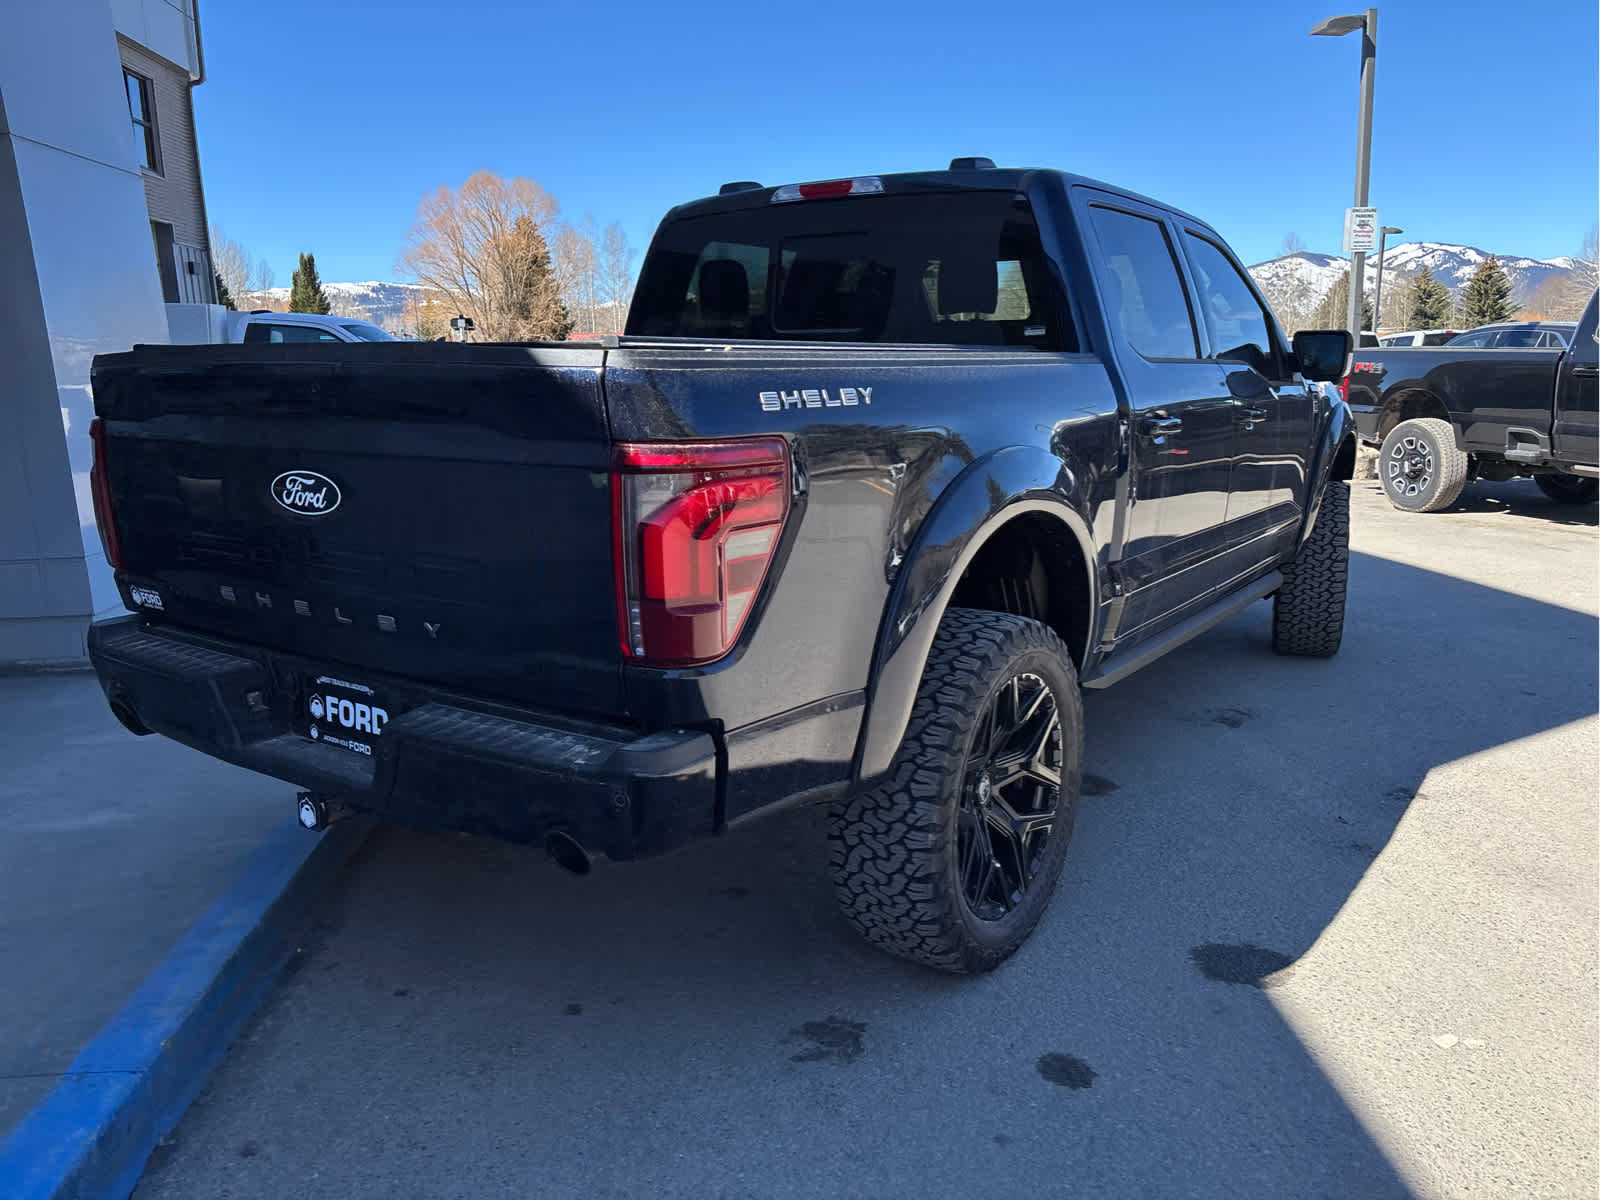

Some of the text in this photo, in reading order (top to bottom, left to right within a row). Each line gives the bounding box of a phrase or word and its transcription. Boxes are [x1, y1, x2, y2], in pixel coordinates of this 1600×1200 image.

[759, 387, 873, 412] SHELBY
[282, 475, 328, 509] Ford
[140, 592, 163, 606] FORD
[219, 585, 441, 640] SHELBY
[325, 695, 389, 736] FORD
[348, 740, 372, 756] FORD
